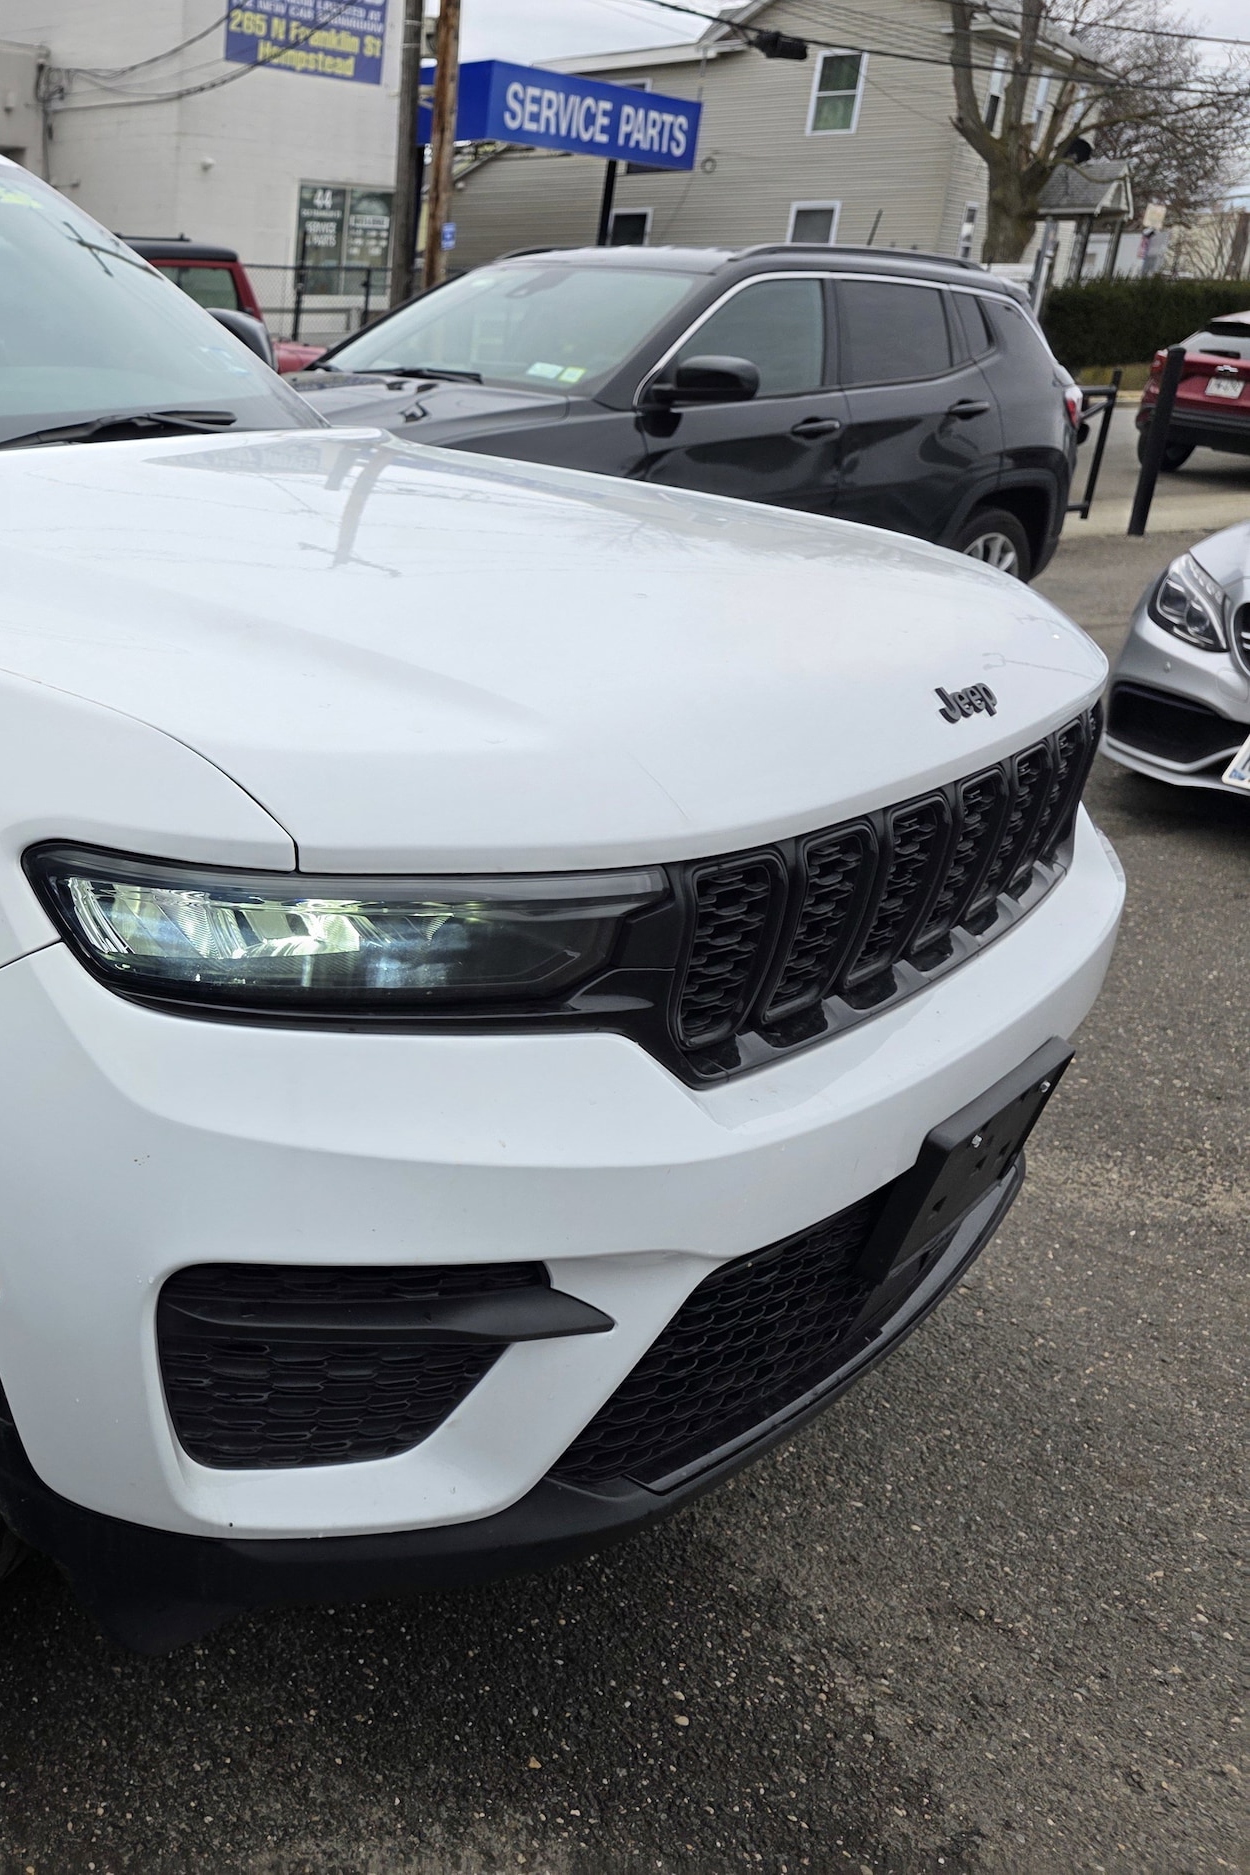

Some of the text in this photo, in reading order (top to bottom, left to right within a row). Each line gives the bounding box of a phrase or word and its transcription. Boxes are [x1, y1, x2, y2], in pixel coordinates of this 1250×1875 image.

[229, 8, 267, 37] 265
[271, 17, 287, 40] N
[289, 20, 360, 54] Franklin
[363, 34, 382, 58] St
[257, 39, 356, 77] Hempstead
[503, 81, 689, 157] SERVICE PARTS
[313, 188, 333, 209] 44
[934, 682, 998, 724] Jeep
